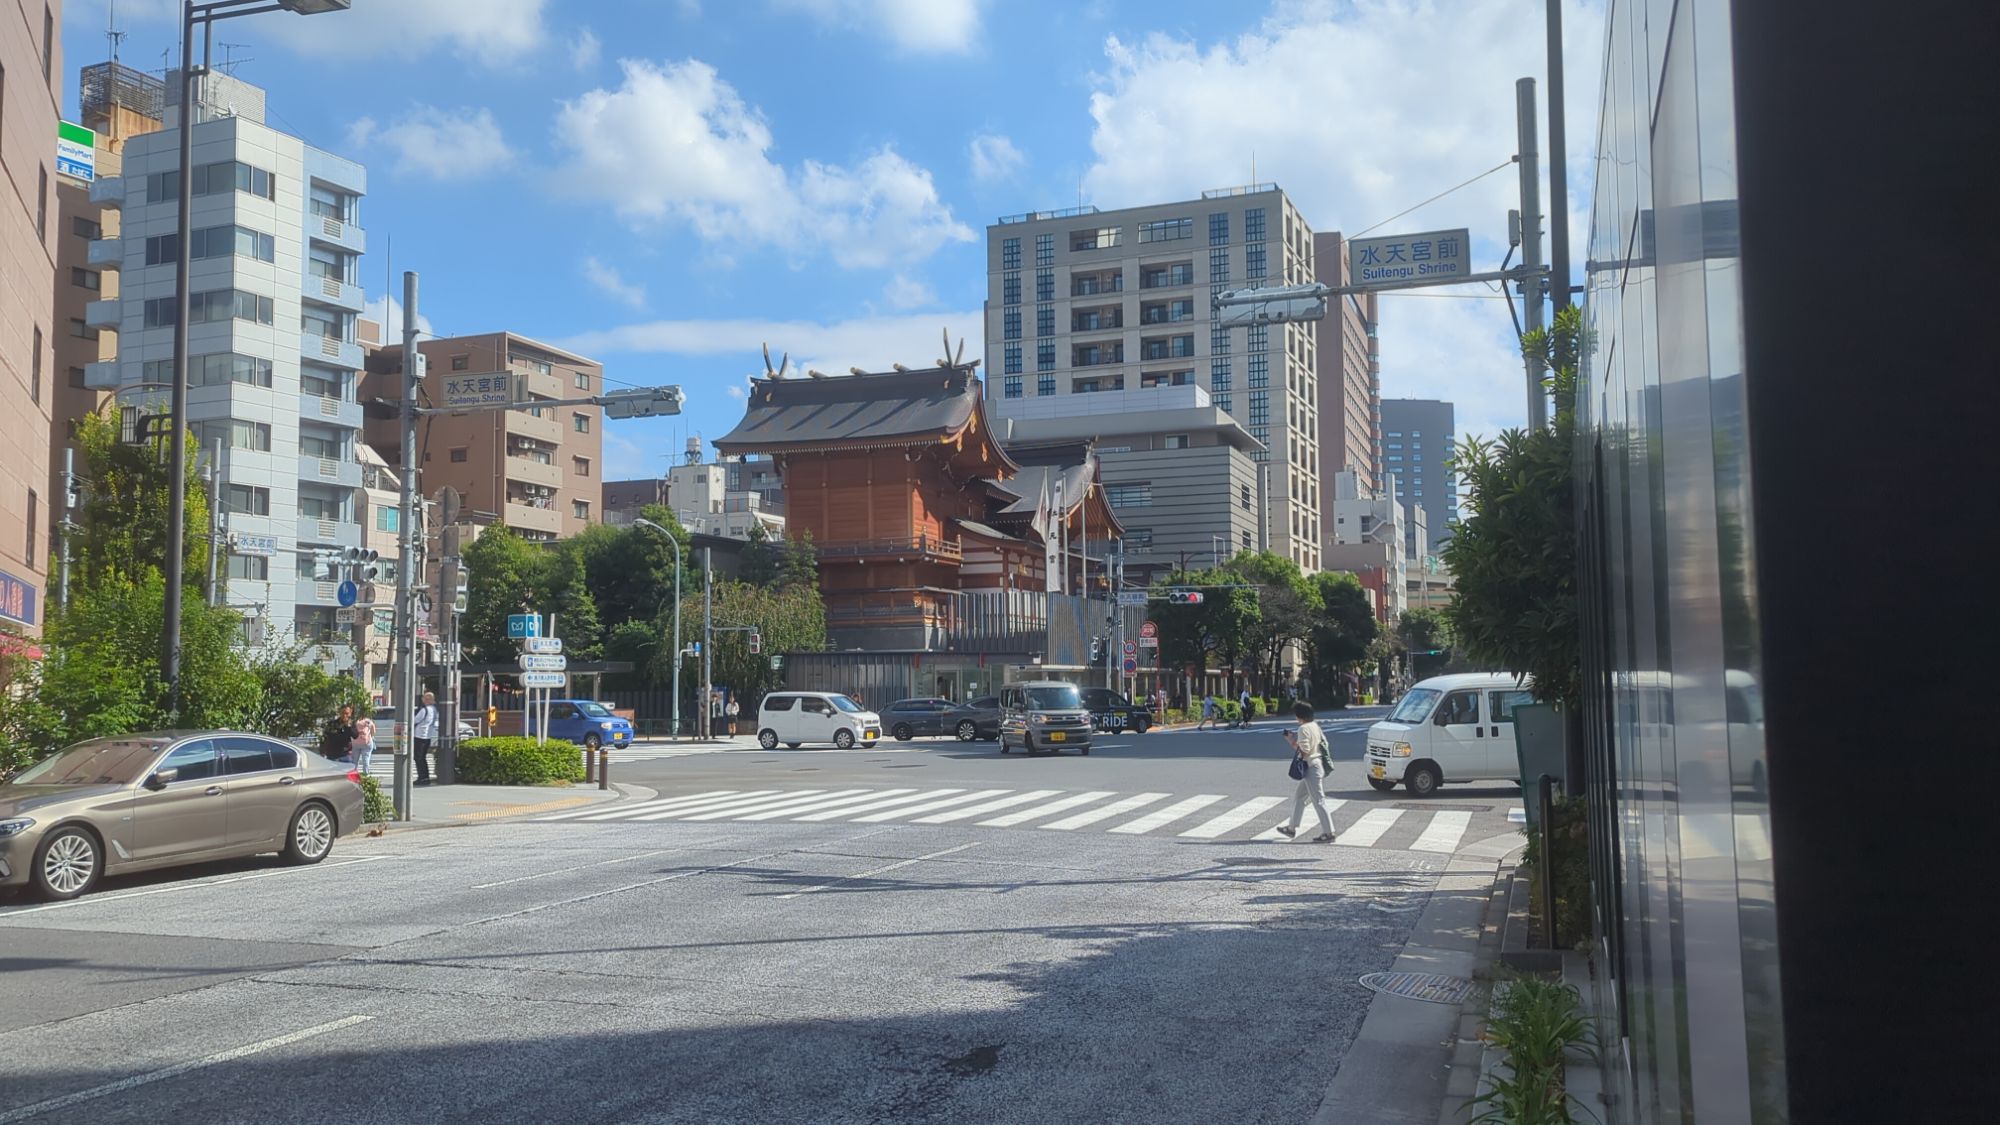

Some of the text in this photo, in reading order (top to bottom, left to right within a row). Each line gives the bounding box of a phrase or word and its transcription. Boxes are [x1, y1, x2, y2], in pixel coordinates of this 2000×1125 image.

[58, 143, 92, 159] FamilyMart
[1360, 237, 1459, 265] 水天宮前
[1363, 262, 1457, 280] Suitengu Shrine
[447, 376, 507, 394] 水天宮前
[448, 393, 505, 405] Suitengu Shrine
